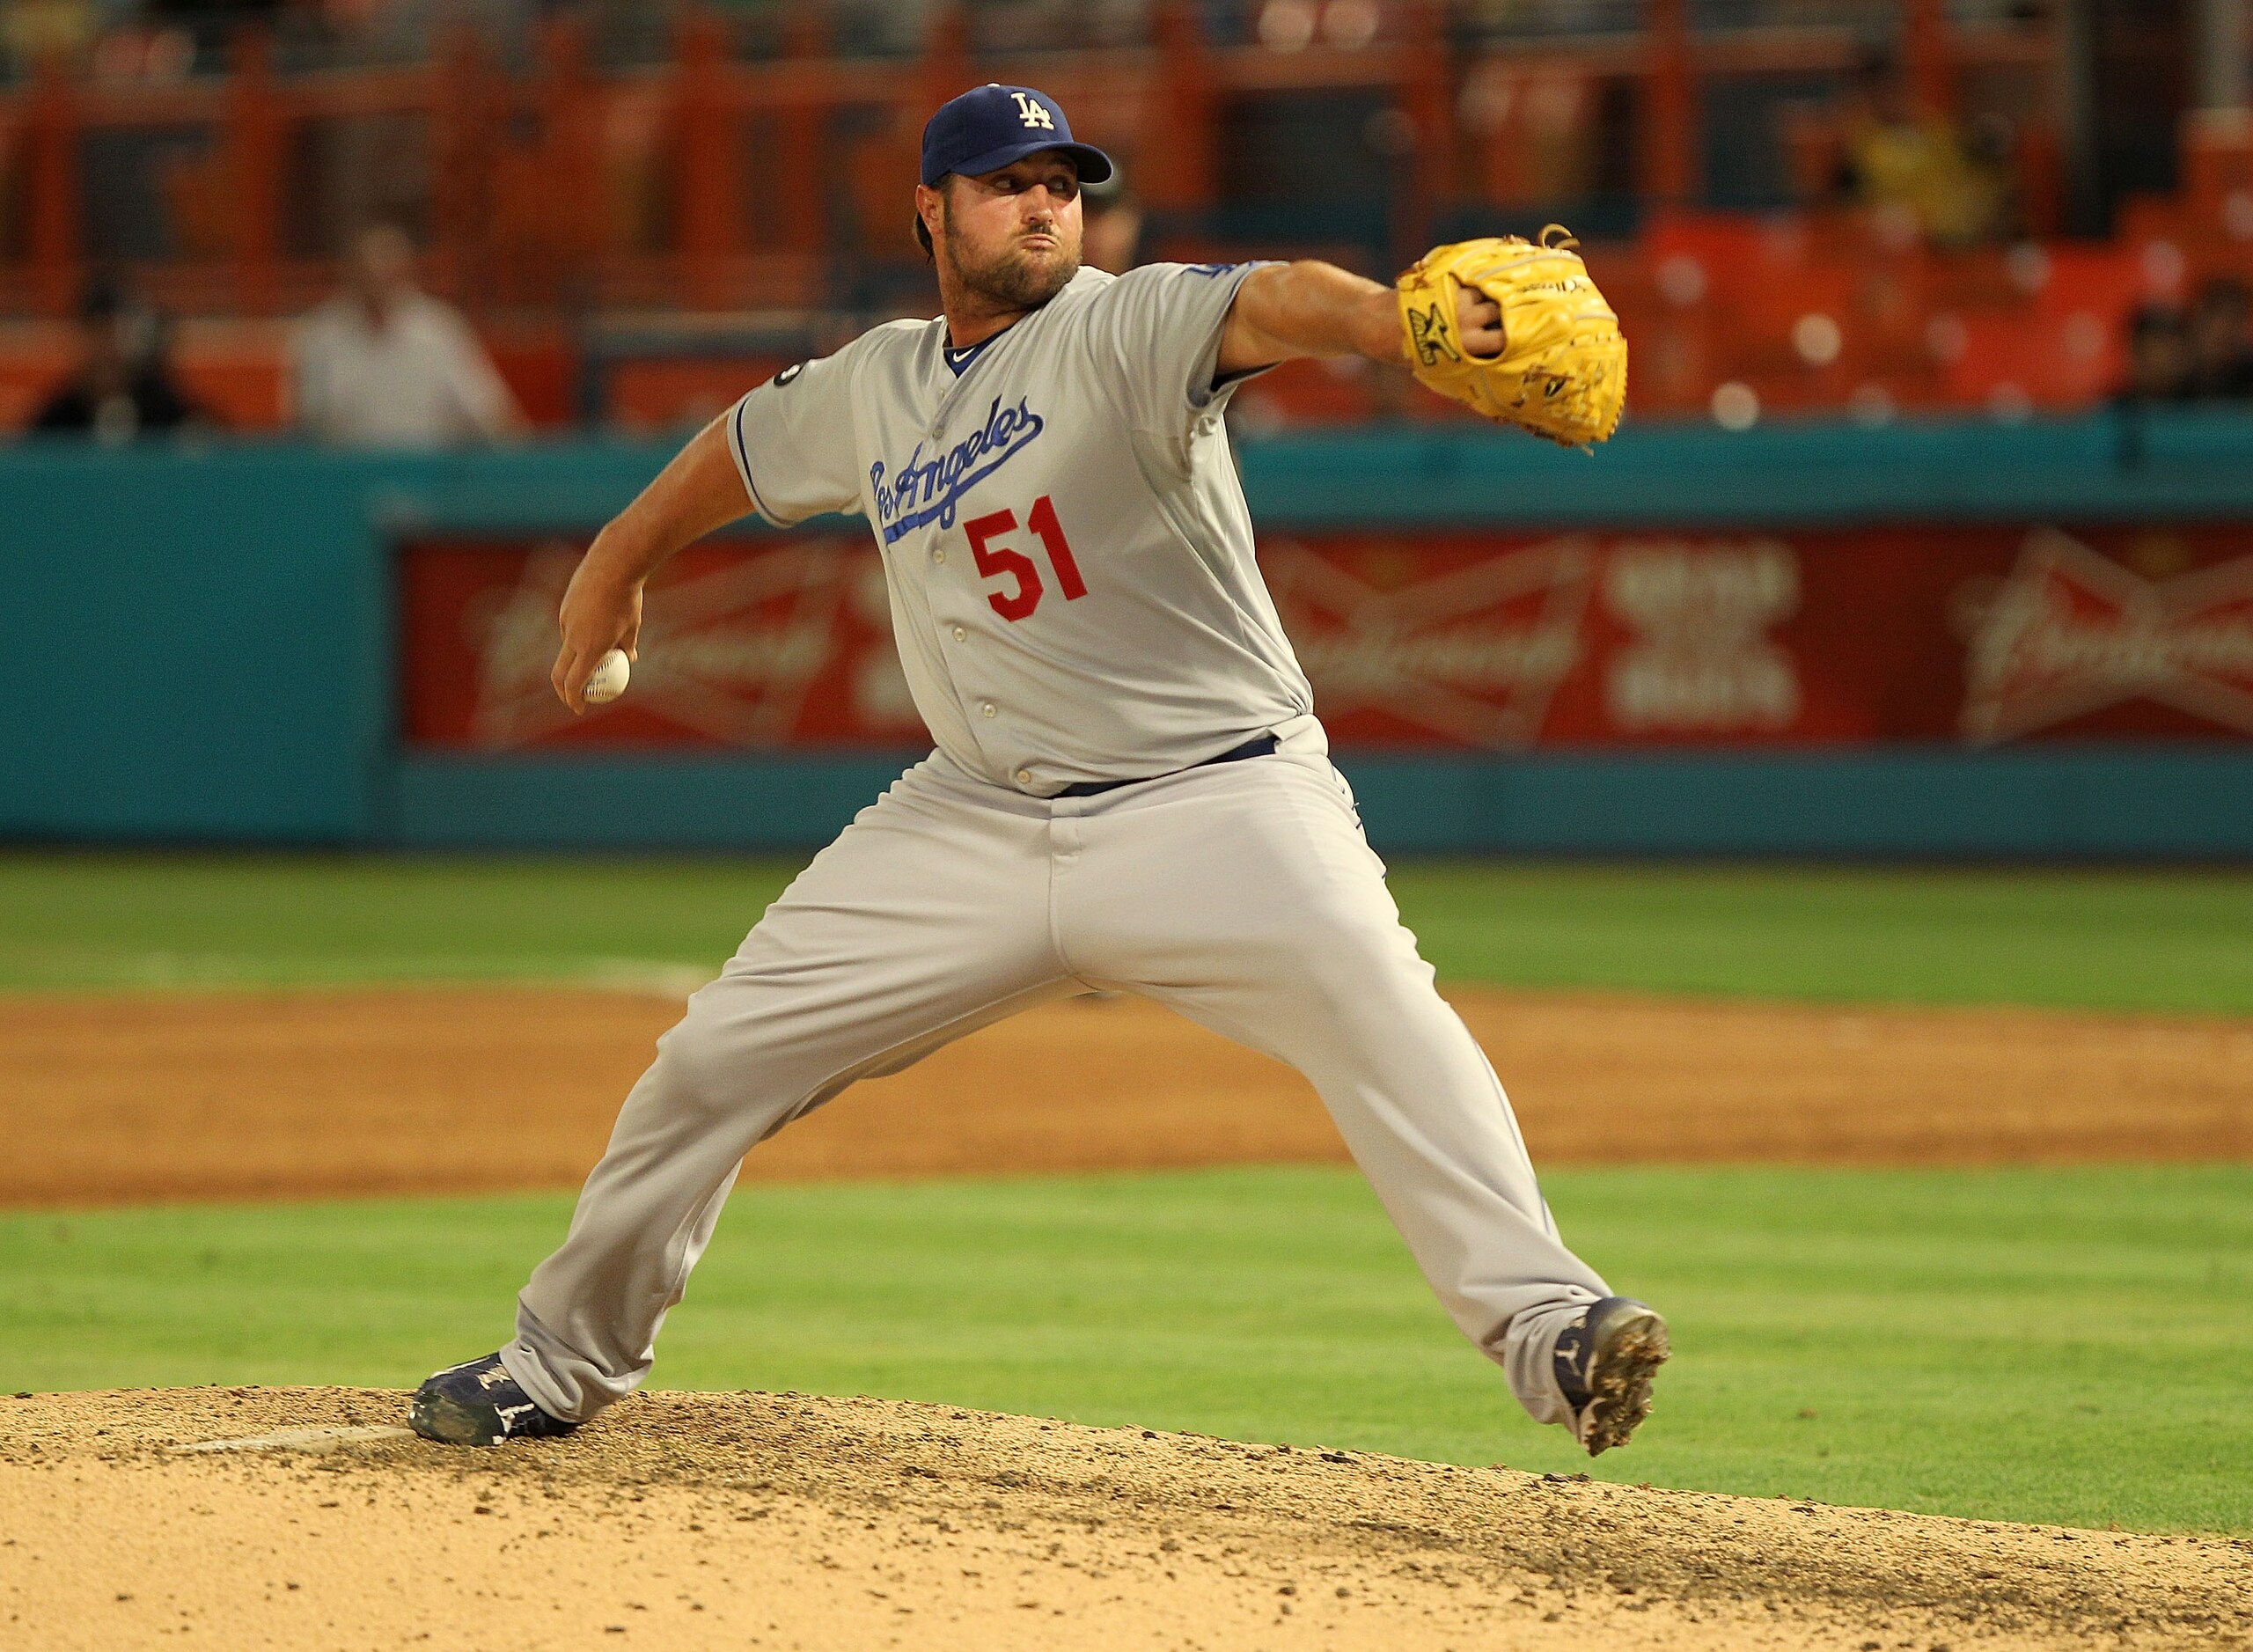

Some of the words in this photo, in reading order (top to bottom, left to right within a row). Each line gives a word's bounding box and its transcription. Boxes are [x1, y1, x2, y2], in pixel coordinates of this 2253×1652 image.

[1011, 92, 1054, 129] LA
[893, 393, 1044, 530] Angeles
[963, 494, 1088, 622] 51
